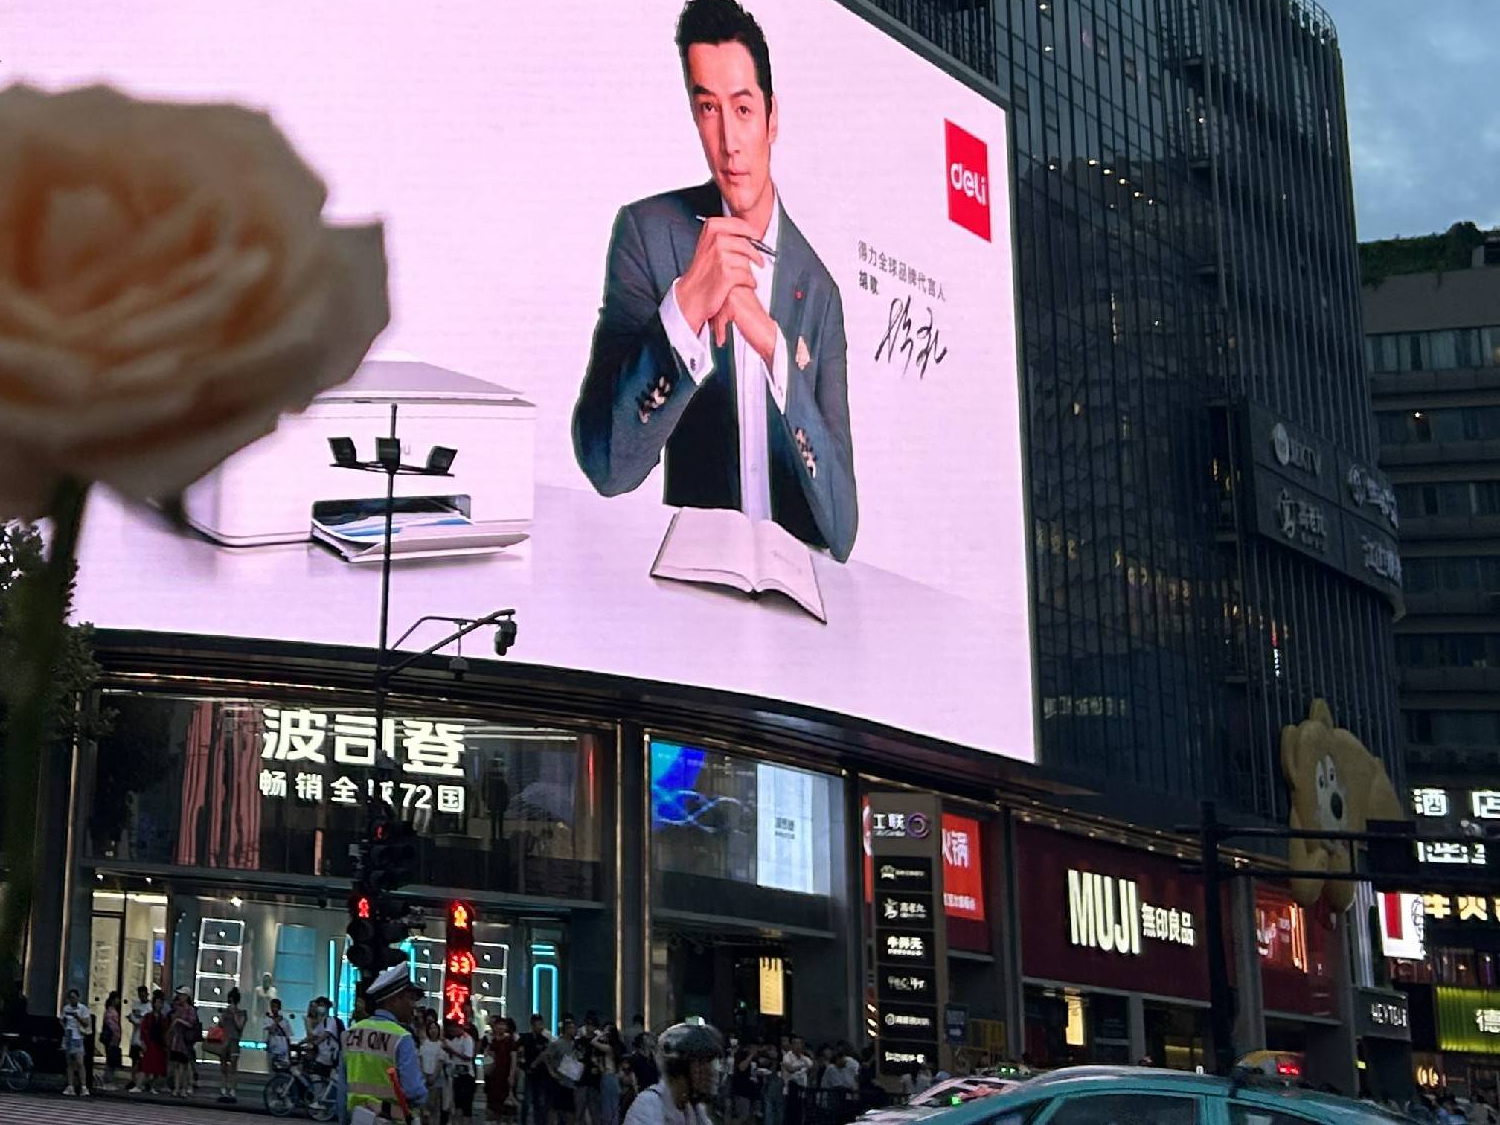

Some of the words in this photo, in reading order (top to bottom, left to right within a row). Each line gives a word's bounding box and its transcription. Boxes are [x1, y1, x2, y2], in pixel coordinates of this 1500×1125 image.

[950, 162, 987, 206] deli
[1068, 868, 1141, 955] MUJI
[1141, 902, 1195, 947] 無印良品
